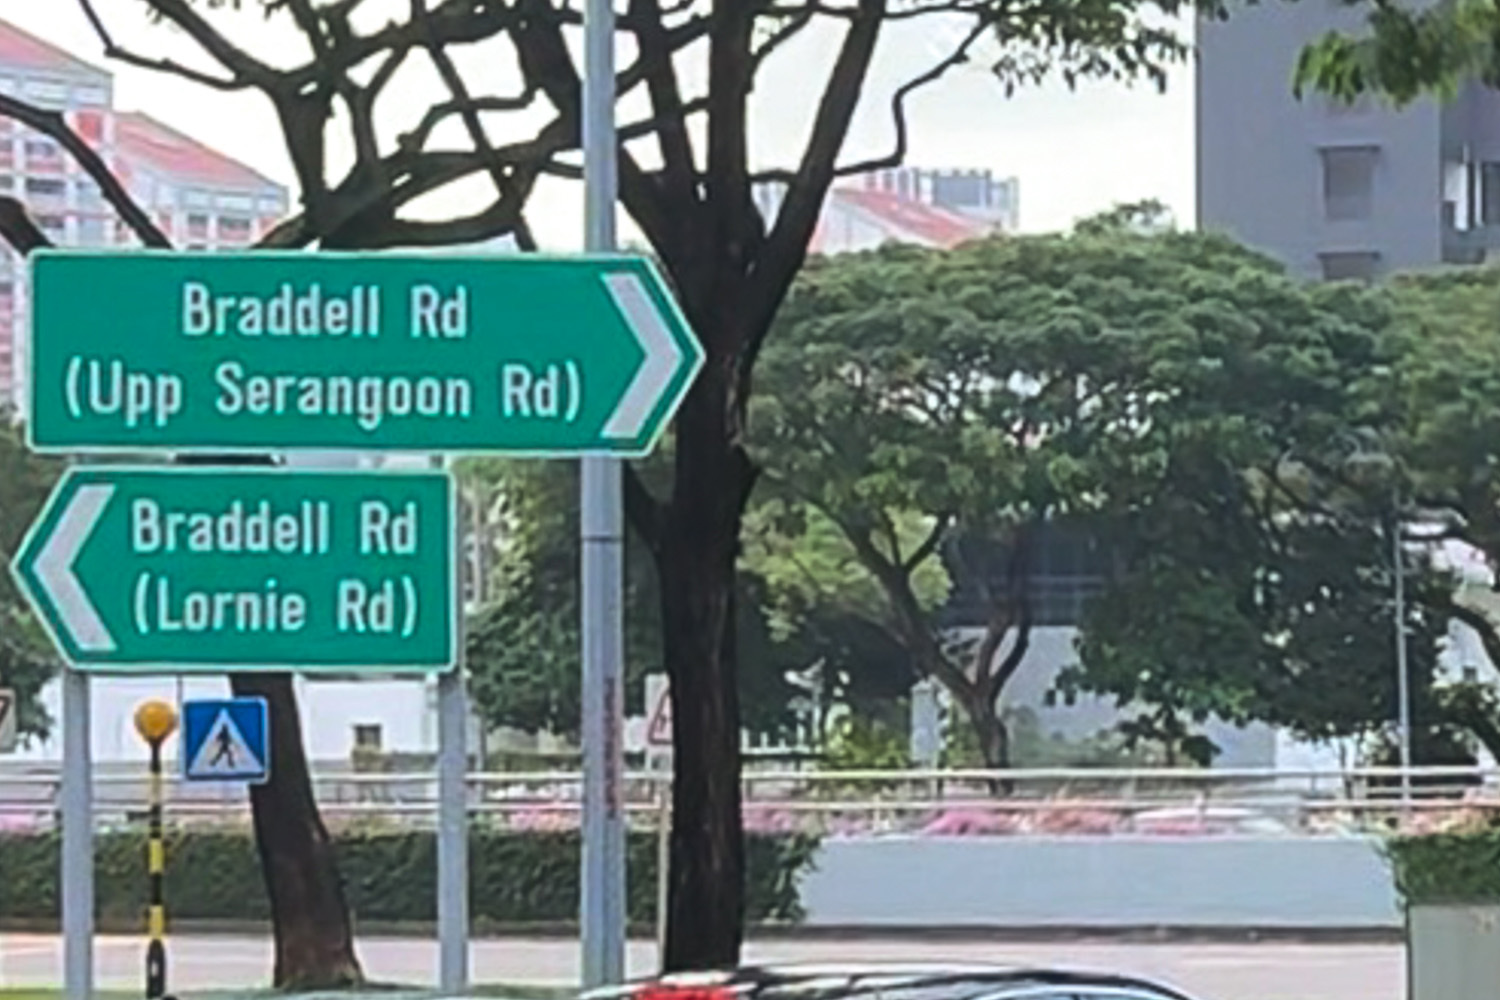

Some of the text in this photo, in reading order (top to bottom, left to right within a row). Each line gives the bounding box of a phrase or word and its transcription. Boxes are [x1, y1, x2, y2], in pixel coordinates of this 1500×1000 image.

[182, 283, 468, 338] Braddell Rd
[65, 356, 581, 429] (Upp Serangoon Rd)
[132, 499, 417, 555] Braddell Rd
[135, 572, 417, 635] (Lornie Rd)
